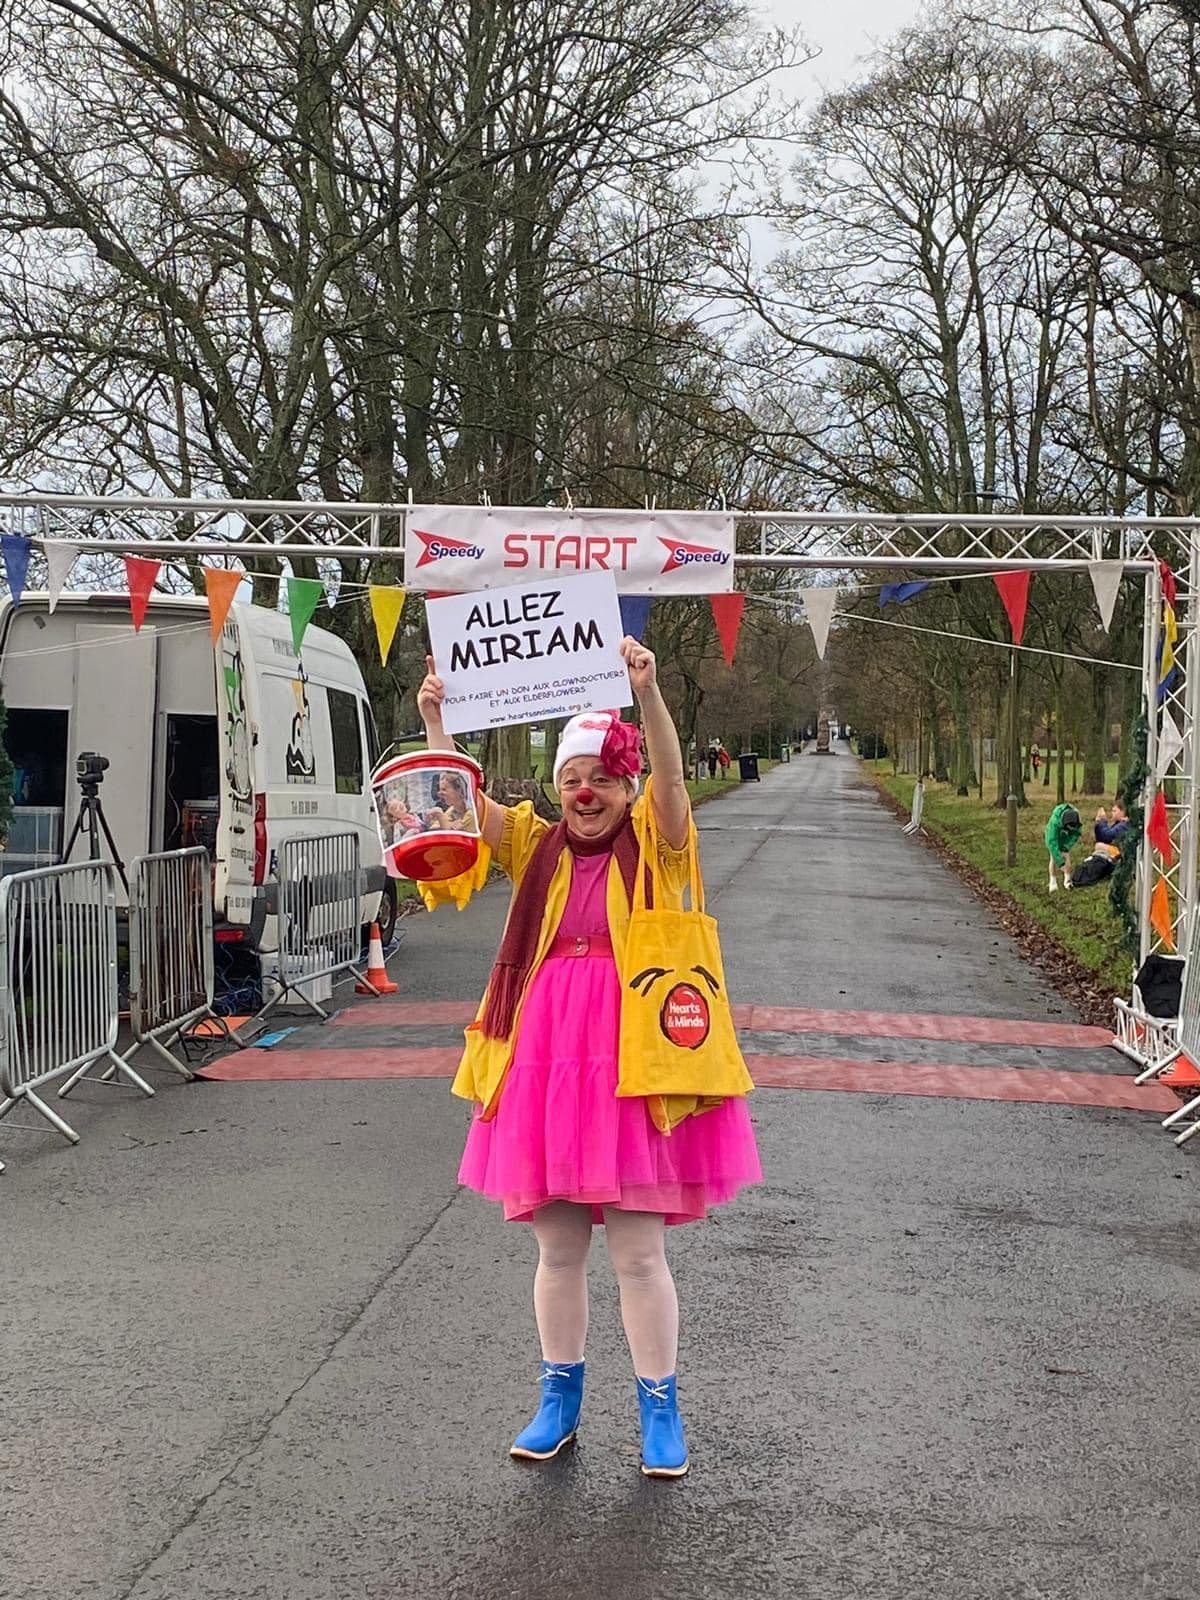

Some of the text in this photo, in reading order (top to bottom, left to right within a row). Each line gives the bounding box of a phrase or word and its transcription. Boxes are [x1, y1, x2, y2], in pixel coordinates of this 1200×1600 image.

[429, 534, 730, 570] Speedy START Speedy
[466, 591, 564, 631] ALLEZ
[451, 619, 604, 672] MIRIAM
[445, 696, 466, 705] POUR
[469, 691, 494, 700] FAIRE
[496, 688, 509, 697] UN
[511, 685, 530, 695] DON
[533, 682, 550, 691] AUX
[489, 686, 586, 708] ET AUX ELDERFLOWERS
[489, 702, 593, 723] www.heartsandminds.org.uk
[669, 1002, 701, 1014] Hearts
